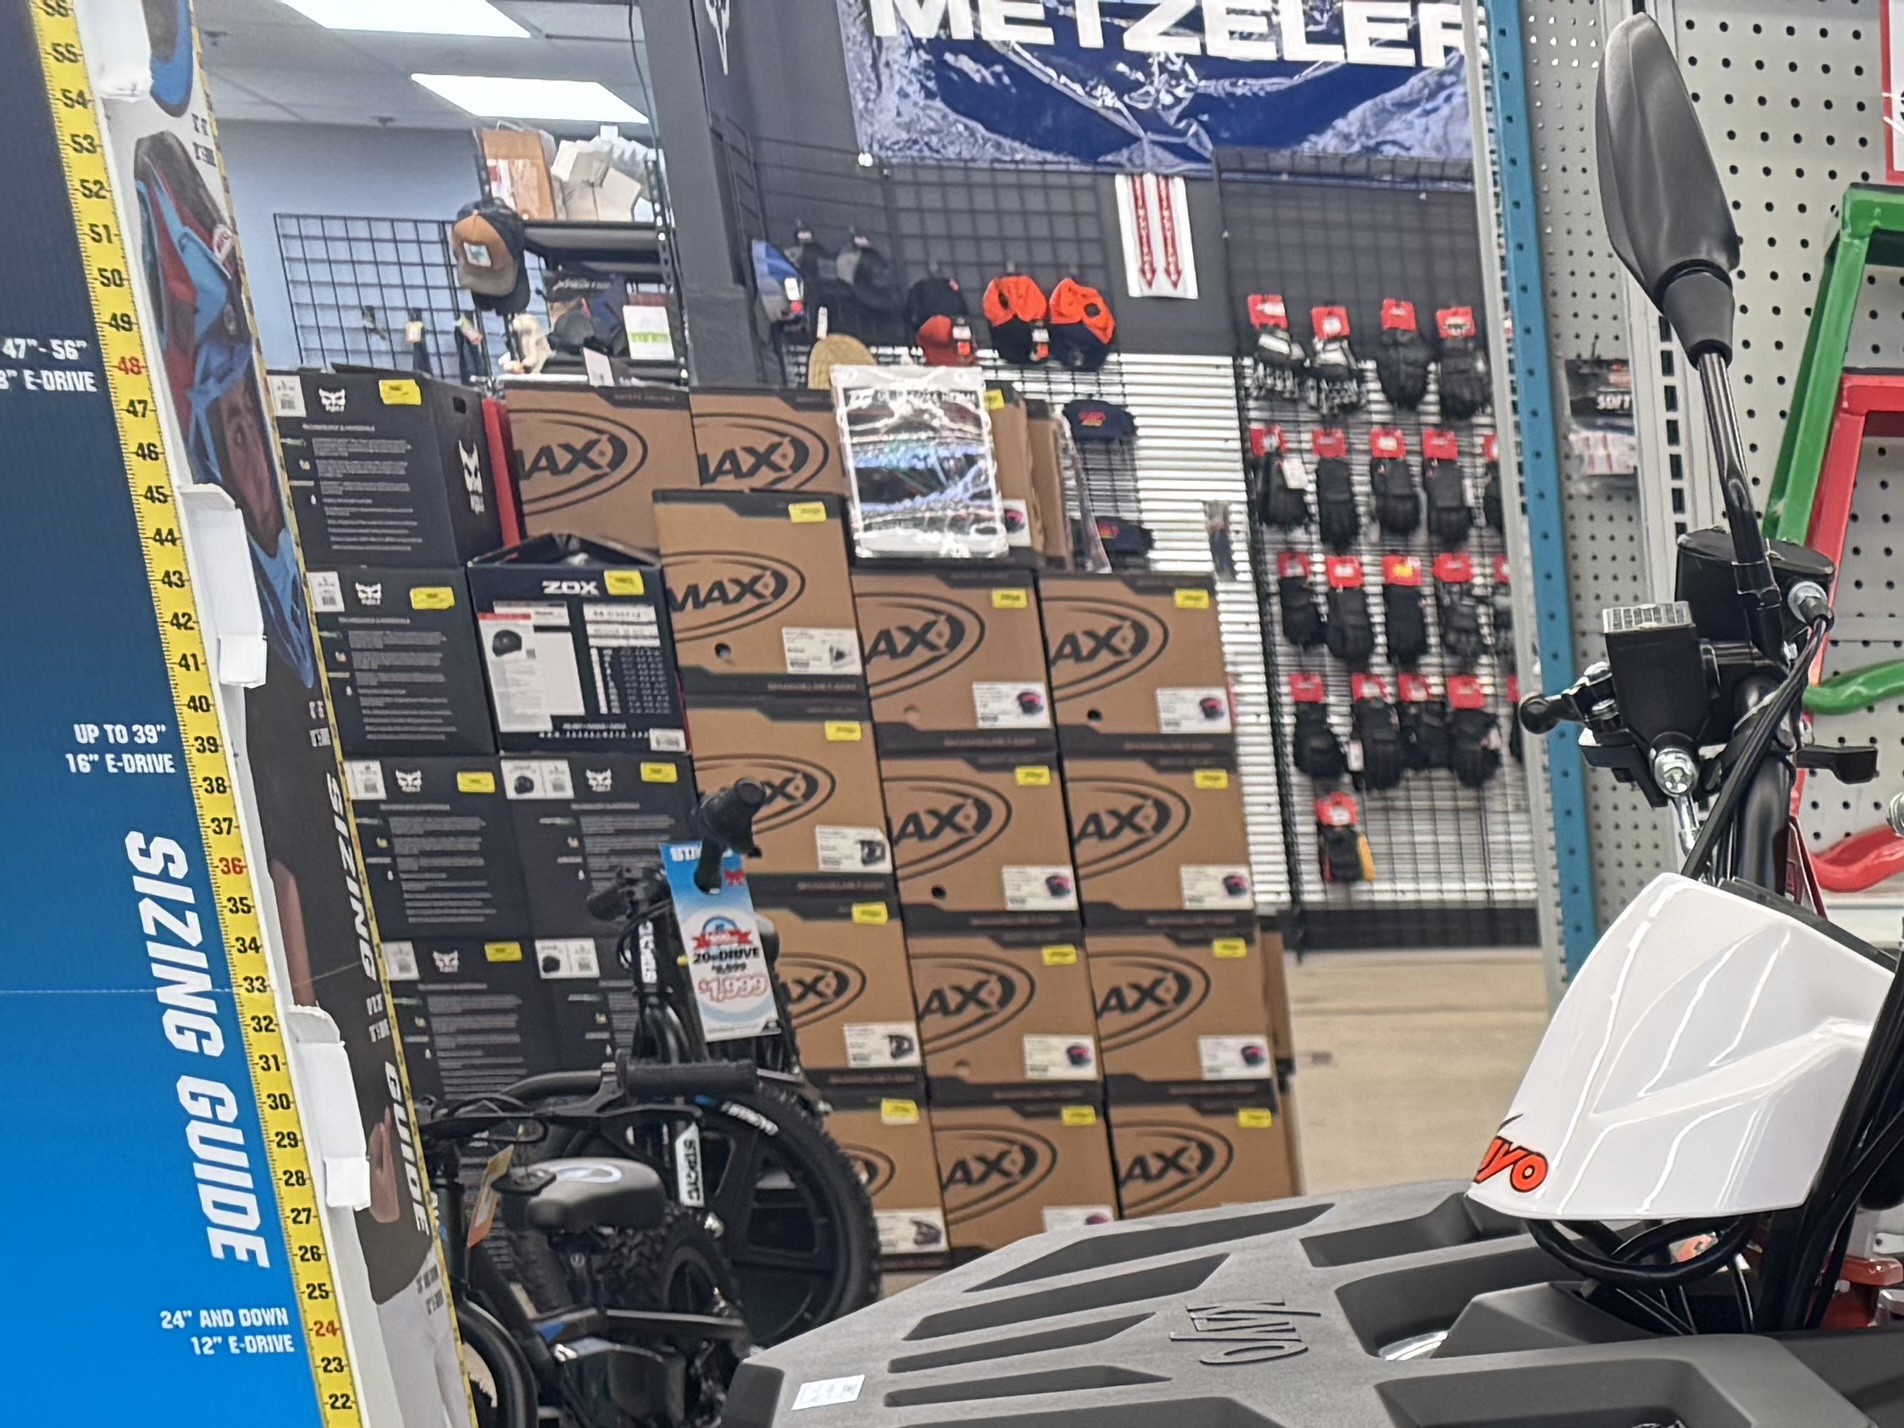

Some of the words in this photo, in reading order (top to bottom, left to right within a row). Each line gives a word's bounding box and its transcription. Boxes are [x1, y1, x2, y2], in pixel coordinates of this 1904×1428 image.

[51, 43, 78, 63] 55
[61, 90, 88, 109] 54
[70, 134, 96, 154] 53
[80, 180, 107, 199] 52
[90, 224, 113, 244] 51
[98, 269, 123, 287] 50
[109, 313, 133, 332] 49
[118, 357, 139, 375] 48
[24, 371, 97, 392] E-DRIVE
[126, 399, 149, 418] 47
[135, 443, 159, 461] 46
[144, 486, 167, 504] 45
[153, 528, 175, 546] 44
[161, 570, 184, 588] 43
[542, 580, 598, 597] ZOX
[170, 613, 193, 631] 42
[179, 654, 200, 671] 41
[187, 695, 210, 713] 40
[73, 724, 100, 744] UP
[103, 724, 129, 744] TO
[194, 736, 219, 753] 39
[105, 753, 177, 774] E-DRIVE
[203, 777, 227, 795] 38
[210, 817, 233, 837] 37
[219, 856, 242, 875] 36
[227, 897, 252, 915] 35
[235, 936, 260, 955] 34
[243, 976, 268, 994] 33
[251, 1015, 276, 1033] 32
[124, 830, 225, 1057] SIZING
[177, 1073, 270, 1269] GUIDE
[259, 1054, 282, 1072] 31
[266, 1093, 291, 1111] 30
[275, 1131, 299, 1149] 29
[385, 1061, 430, 1234] GUIDE
[282, 1169, 306, 1187] 28
[290, 1208, 312, 1225] 27
[299, 1245, 322, 1263] 26
[306, 1282, 330, 1300] 25
[200, 1309, 234, 1328] AND
[239, 1308, 288, 1328] DOWN
[314, 1320, 338, 1337] 24
[228, 1334, 294, 1354] E-DRIVE
[321, 1356, 344, 1374] 23
[329, 1394, 352, 1411] 22
